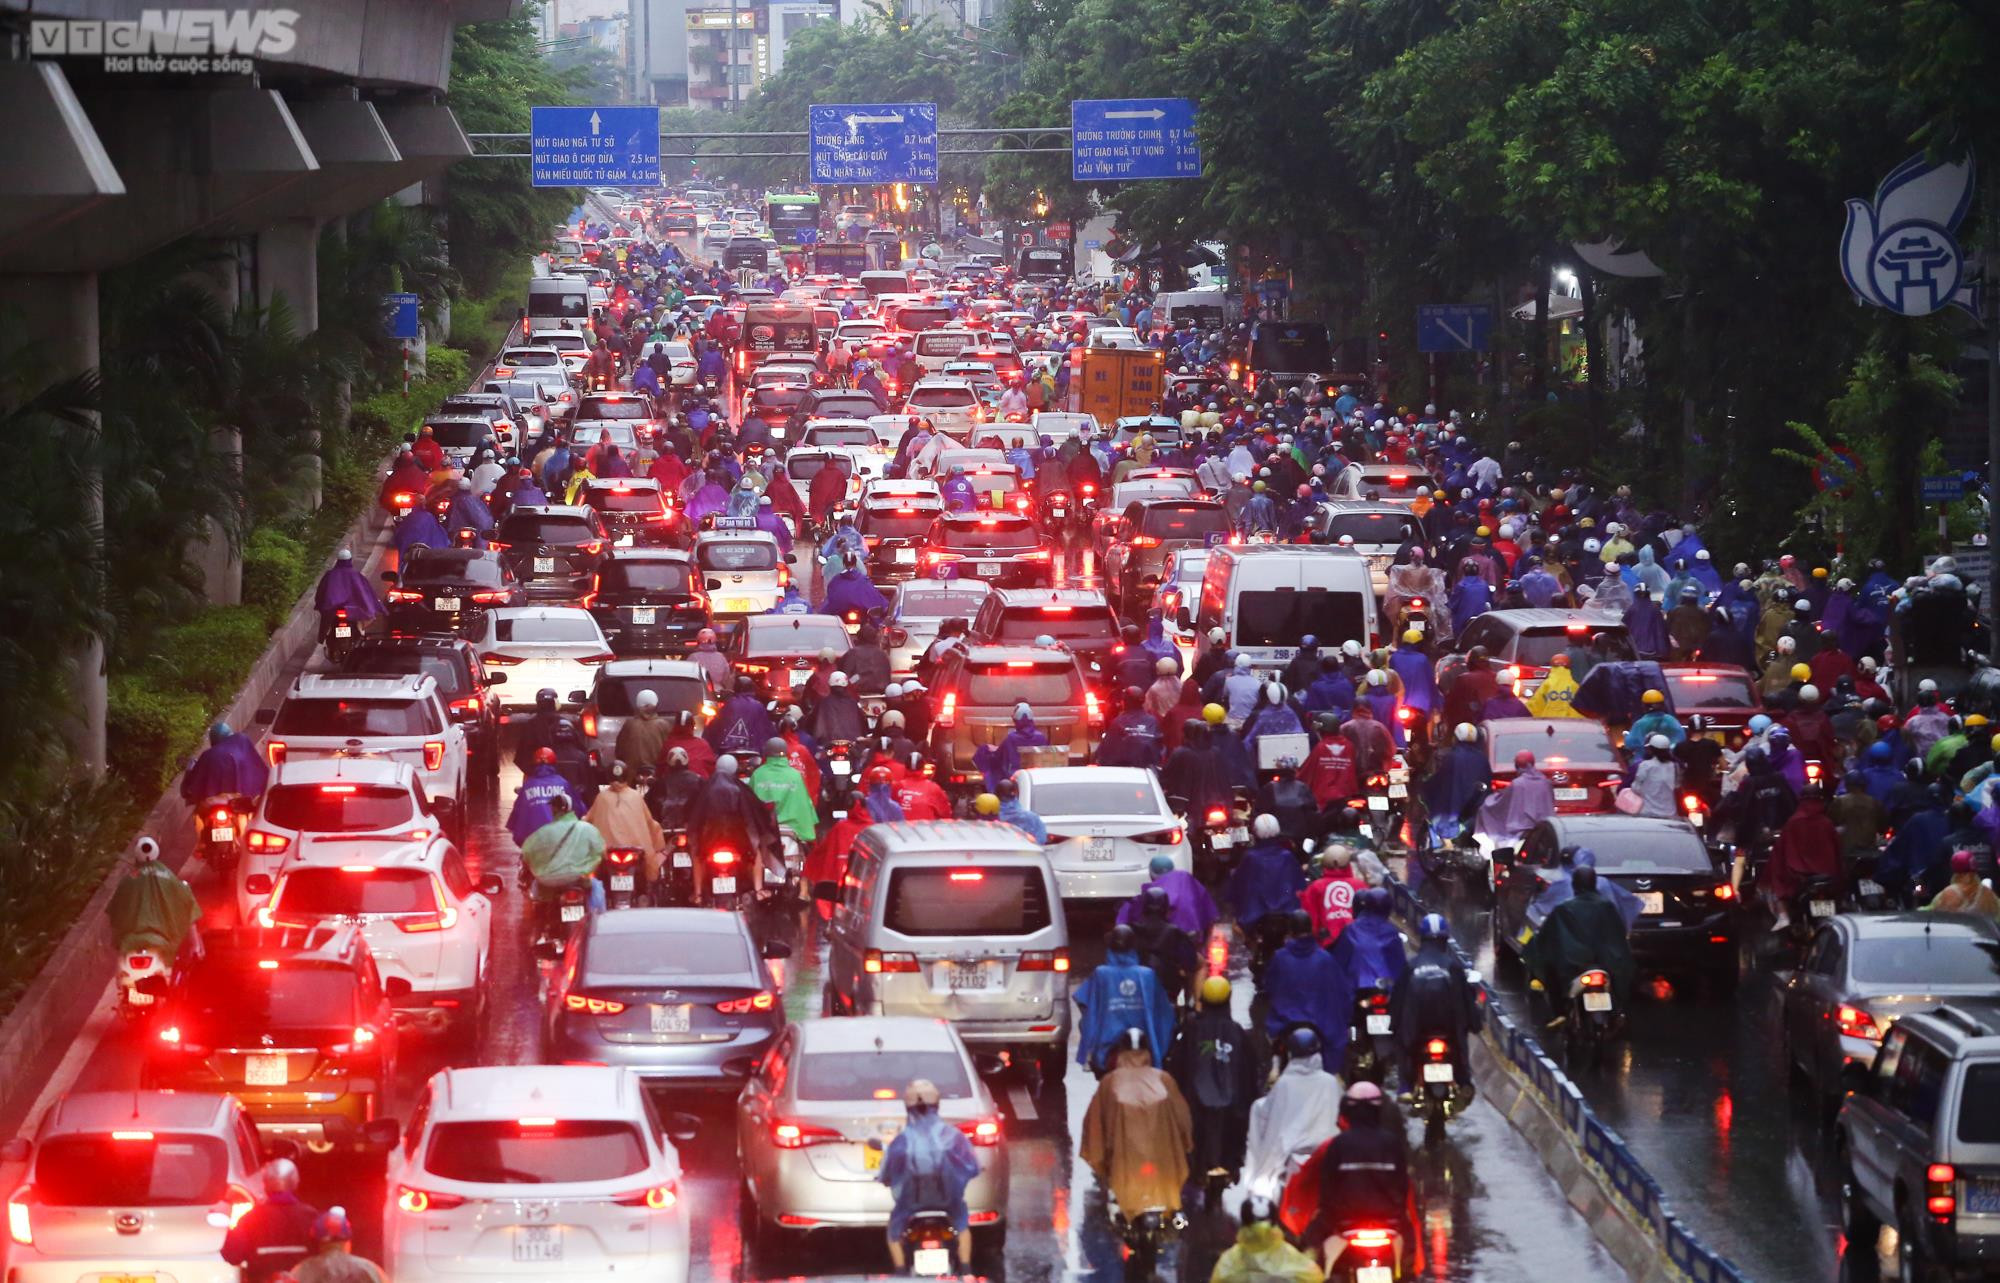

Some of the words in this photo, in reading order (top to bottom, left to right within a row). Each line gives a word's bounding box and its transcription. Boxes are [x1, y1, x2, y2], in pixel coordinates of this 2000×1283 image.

[918, 135, 930, 145] km
[1077, 129, 1103, 141] ĐƯỜNG
[1106, 128, 1136, 140] TRƯỜNG
[1138, 130, 1161, 140] CHINH
[535, 136, 549, 148] NÚT
[552, 138, 570, 148] GIAO
[572, 136, 588, 148] NGÃ
[911, 151, 917, 160] 5
[919, 150, 930, 160] km
[1094, 147, 1112, 157] GIAO
[1113, 145, 1129, 156] NGÃ
[1176, 146, 1181, 154] 3
[1183, 146, 1196, 154] km
[535, 153, 549, 164] NÚT
[552, 154, 570, 164] GIAO
[572, 152, 578, 164] Ô
[645, 153, 657, 164] km
[909, 168, 917, 176] 11
[919, 167, 931, 176] km
[1096, 161, 1114, 173] VĨNH
[1184, 162, 1196, 170] km
[536, 168, 551, 180] VĂN
[552, 167, 571, 180] MIẾU
[573, 168, 593, 180] QUỐC
[608, 168, 627, 180] GIÁM
[645, 169, 657, 179] km
